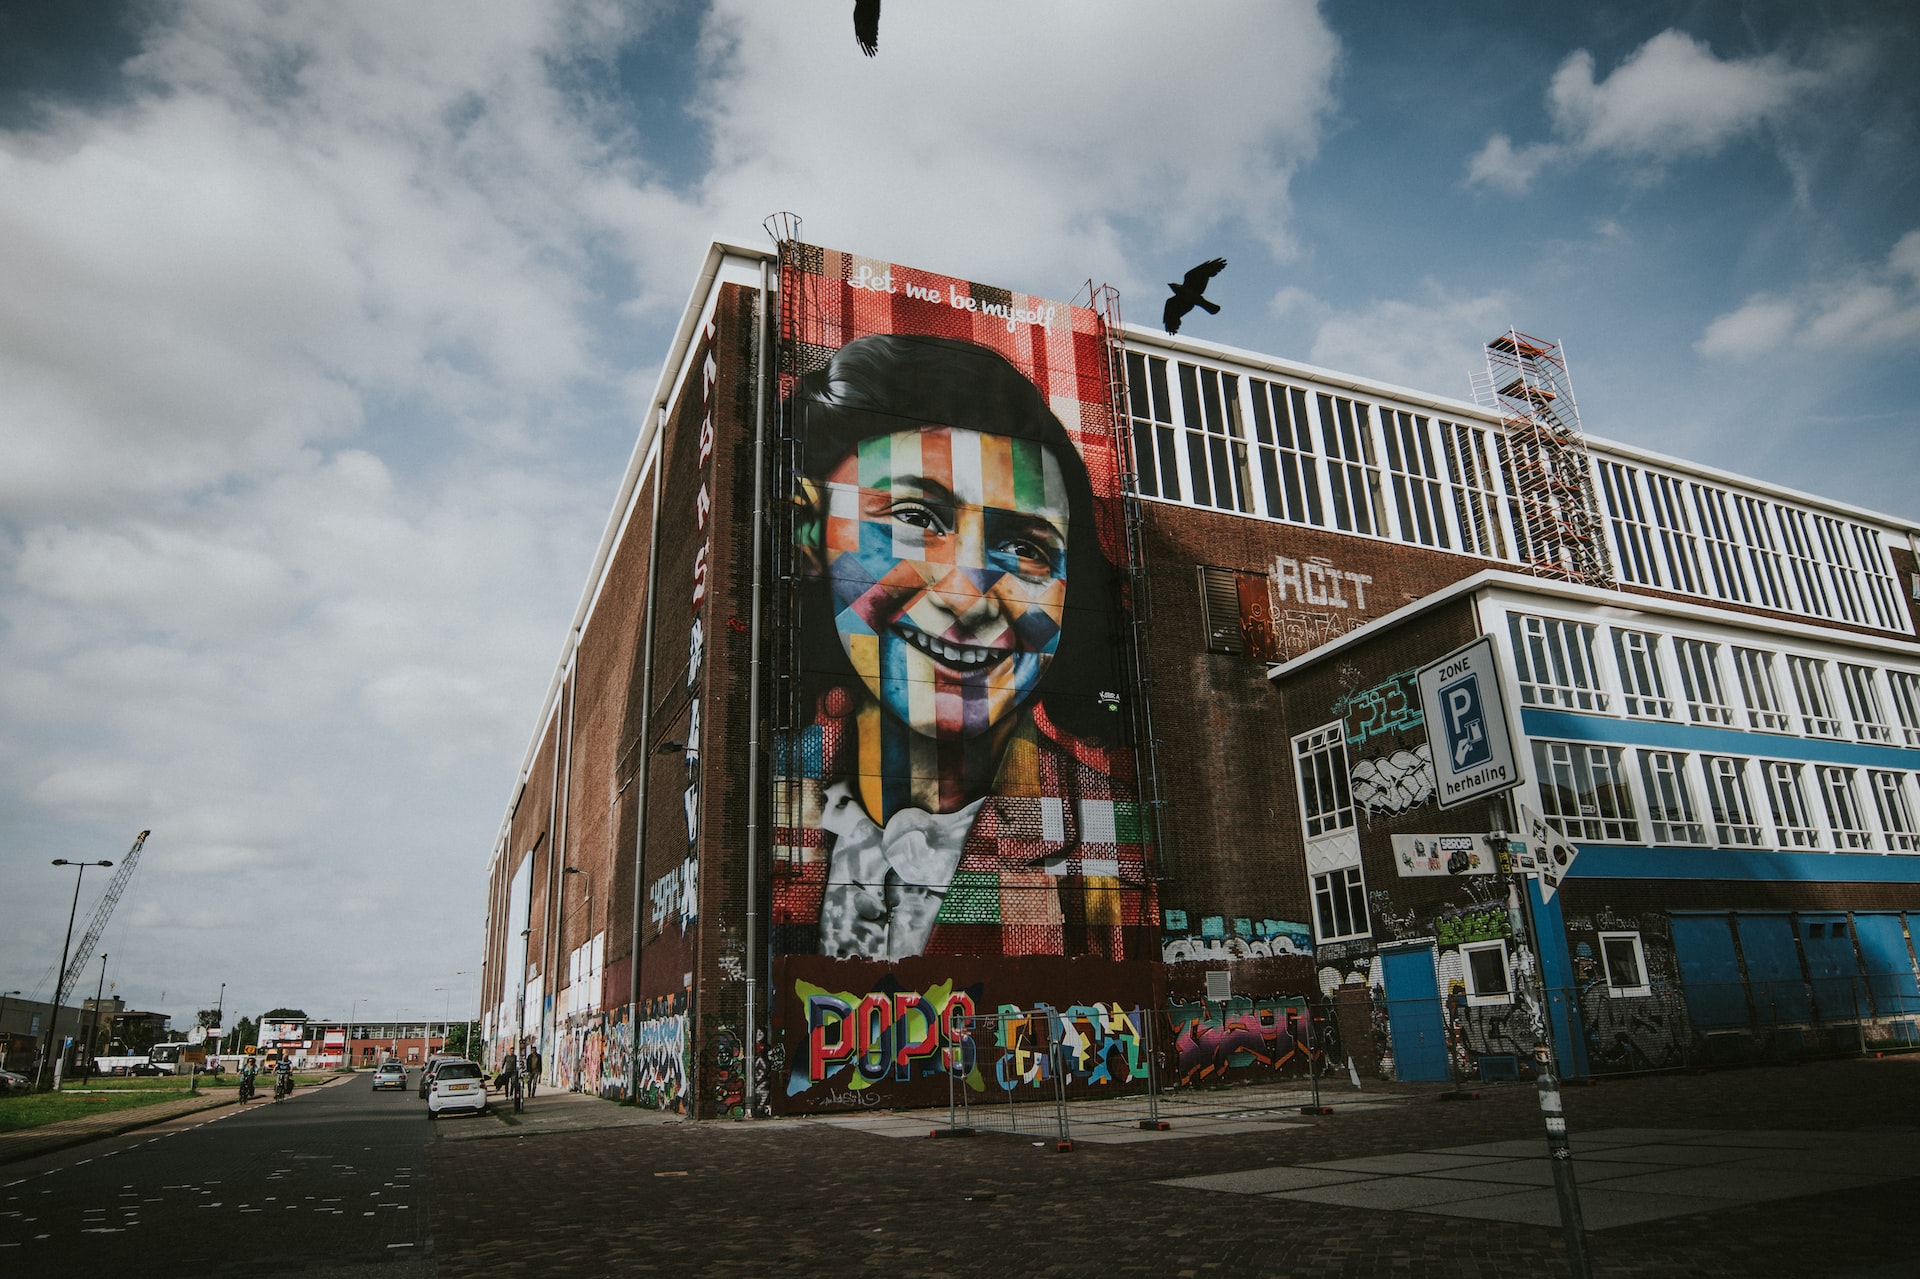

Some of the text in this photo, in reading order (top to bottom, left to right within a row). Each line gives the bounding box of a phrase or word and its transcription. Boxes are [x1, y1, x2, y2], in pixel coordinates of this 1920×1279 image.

[847, 265, 1054, 337] Let me be myself
[1438, 656, 1471, 683] ZONE
[1448, 687, 1472, 735] P
[1446, 764, 1507, 796] herhaling
[806, 989, 977, 1084] POPS
